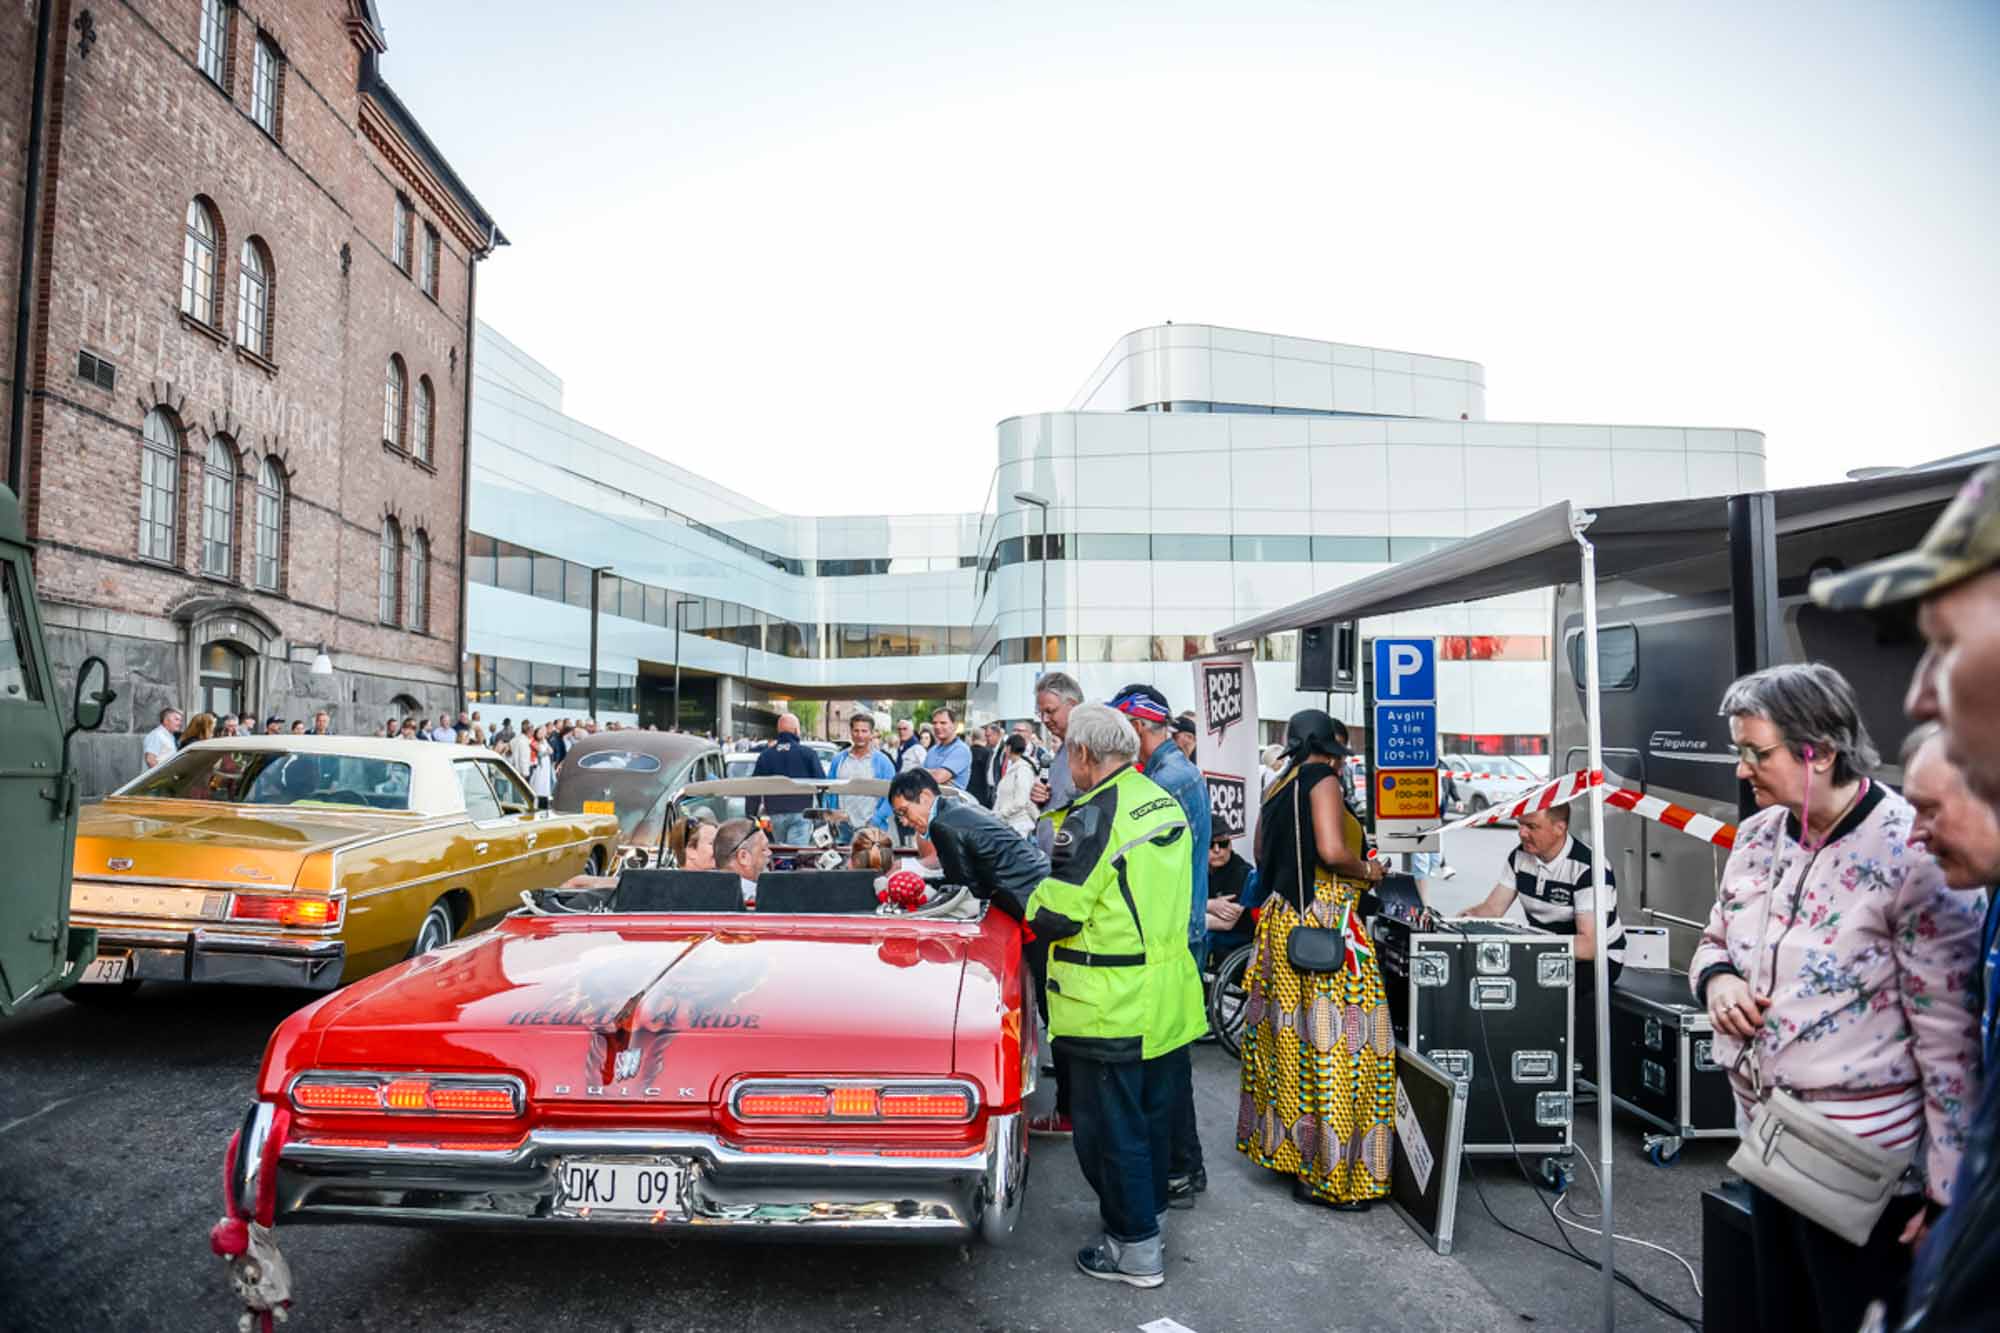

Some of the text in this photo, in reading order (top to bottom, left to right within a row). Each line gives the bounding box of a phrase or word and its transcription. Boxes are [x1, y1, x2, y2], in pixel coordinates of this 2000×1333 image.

[1388, 644, 1424, 696] P
[1208, 672, 1233, 701] POP
[1210, 694, 1241, 723] ROCK
[1388, 711, 1425, 722] Avgift
[1391, 724, 1422, 734] 3 tim
[1209, 784, 1236, 809] POP
[96, 959, 123, 979] 737
[688, 1008, 760, 1029] RIDE
[555, 1085, 695, 1097] BUICK
[569, 1168, 616, 1202] DKJ
